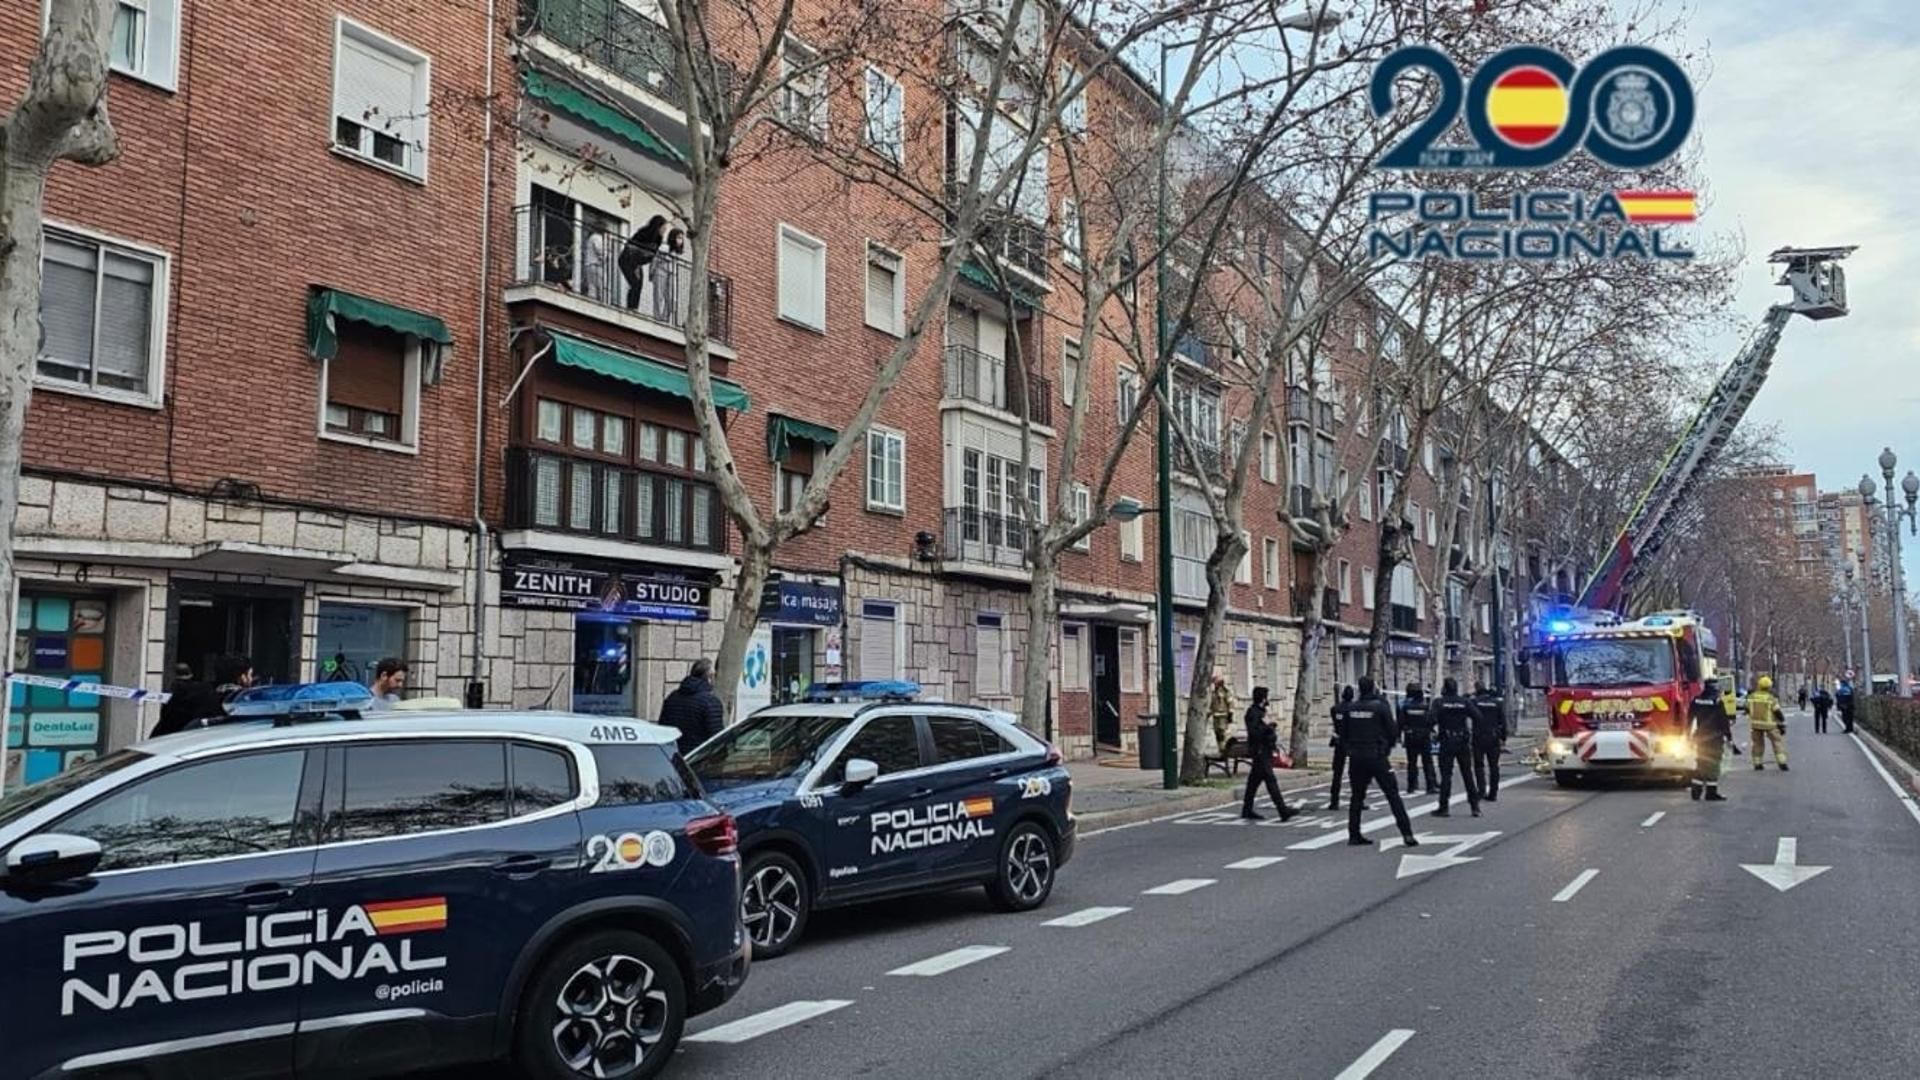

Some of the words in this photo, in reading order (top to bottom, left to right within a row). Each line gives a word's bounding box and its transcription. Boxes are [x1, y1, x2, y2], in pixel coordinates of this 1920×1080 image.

[514, 571, 592, 594] ZENITH
[636, 583, 701, 603] STUDIO
[801, 596, 838, 613] masaje
[590, 726, 638, 741] 4MB
[1018, 776, 1052, 799] 200
[870, 800, 970, 832] POLICIA
[587, 830, 676, 873] 200
[870, 819, 995, 855] NACIONAL
[63, 904, 377, 972] POLICIA
[61, 939, 447, 1016] NACIONAL
[375, 978, 443, 1000] @policia
